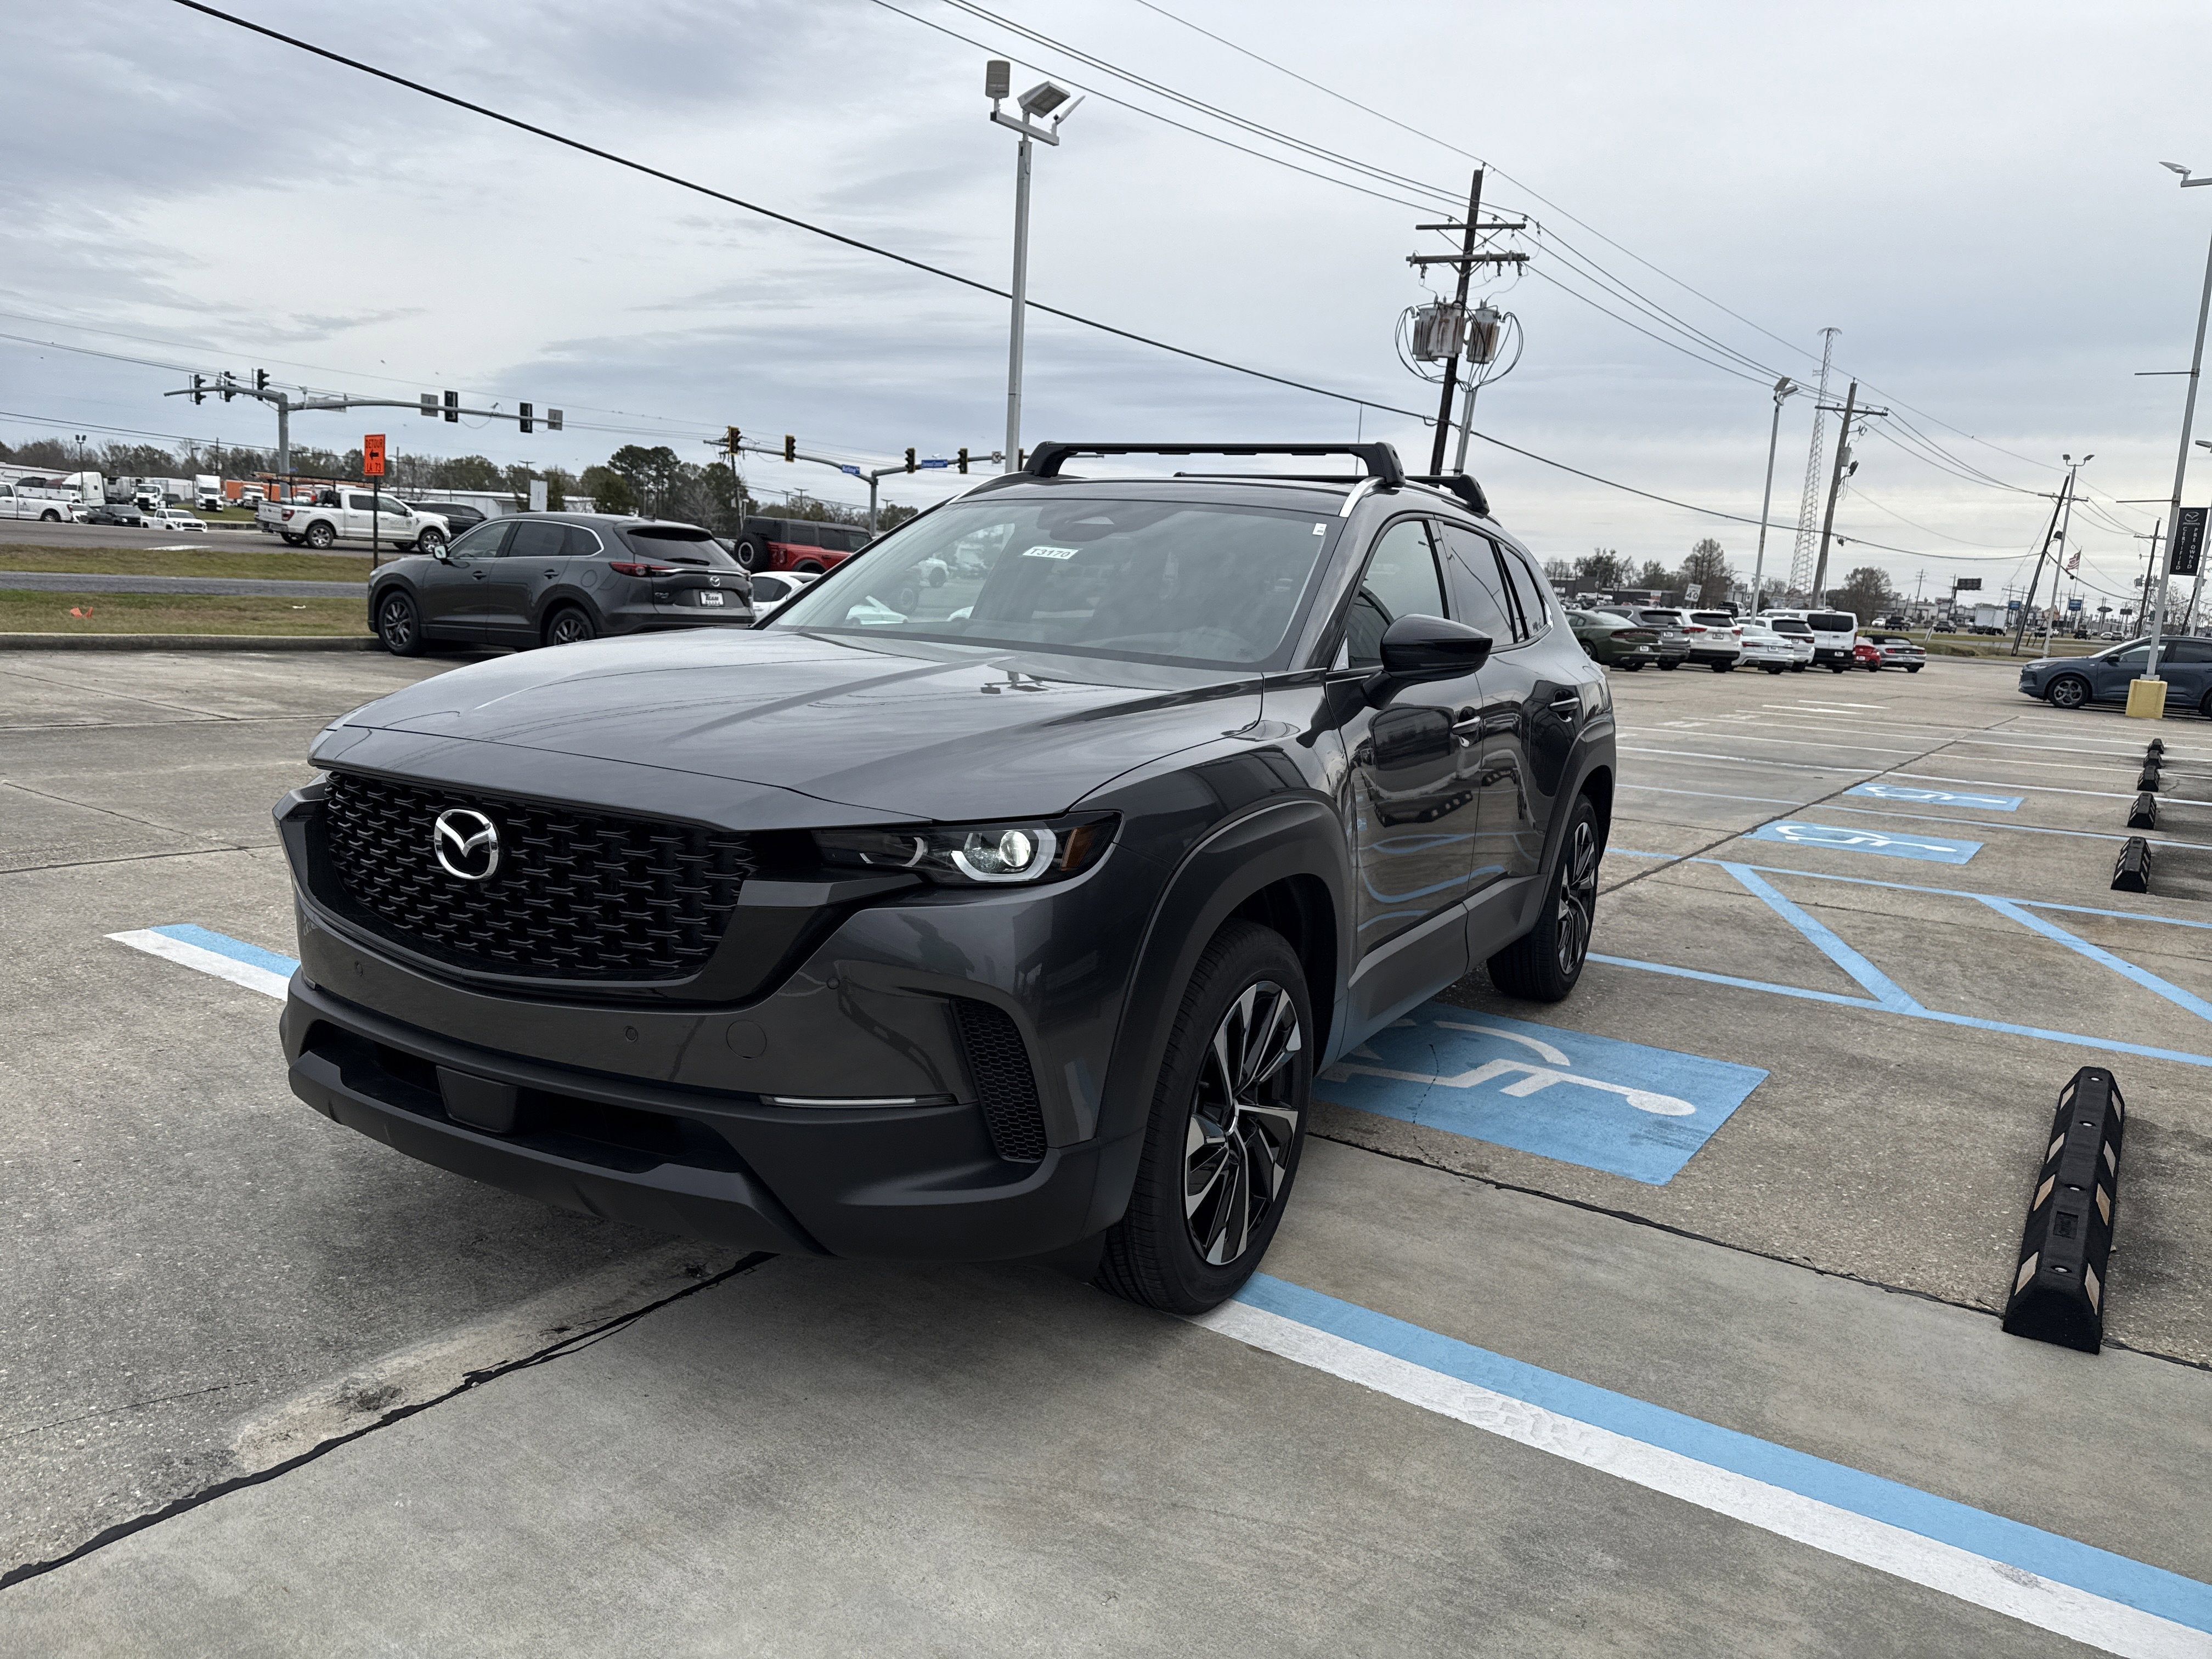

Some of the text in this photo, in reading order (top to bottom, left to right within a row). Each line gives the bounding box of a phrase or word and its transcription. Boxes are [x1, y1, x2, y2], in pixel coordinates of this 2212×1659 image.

[365, 439, 383, 448] DETOUR
[366, 462, 381, 472] LA 73
[1030, 549, 1071, 557] T3170
[2176, 527, 2187, 570] CERTIFIED
[2187, 544, 2196, 569] OWNED
